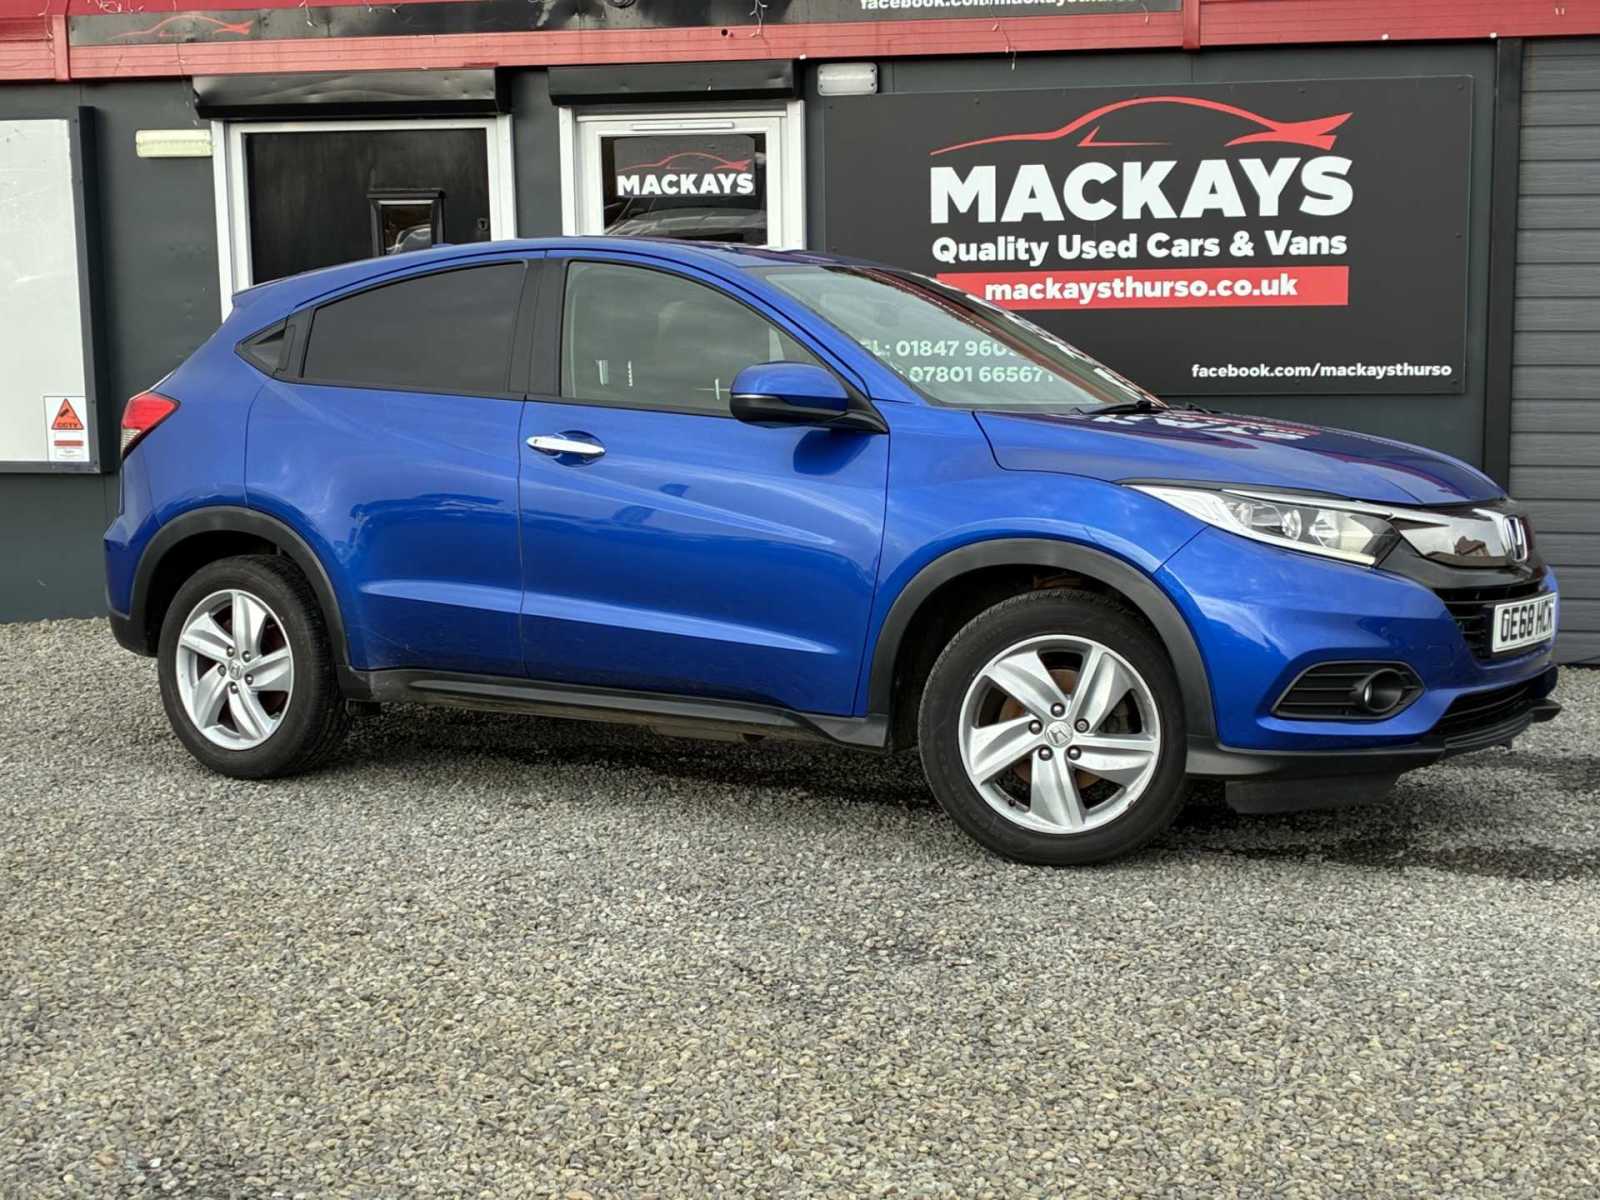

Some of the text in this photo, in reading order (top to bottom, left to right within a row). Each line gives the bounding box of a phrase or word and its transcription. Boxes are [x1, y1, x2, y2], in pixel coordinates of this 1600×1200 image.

[616, 172, 754, 196] MACKAYS
[931, 156, 1353, 224] MACKAYS
[932, 229, 1348, 266] Quality Used Cars & Vans
[985, 273, 1298, 304] mackaysthurso.co.uk
[895, 340, 959, 356] 01847
[964, 338, 1017, 357] 960
[909, 365, 973, 382] 07801
[1191, 362, 1453, 380] facebook.com/mackaysthurso
